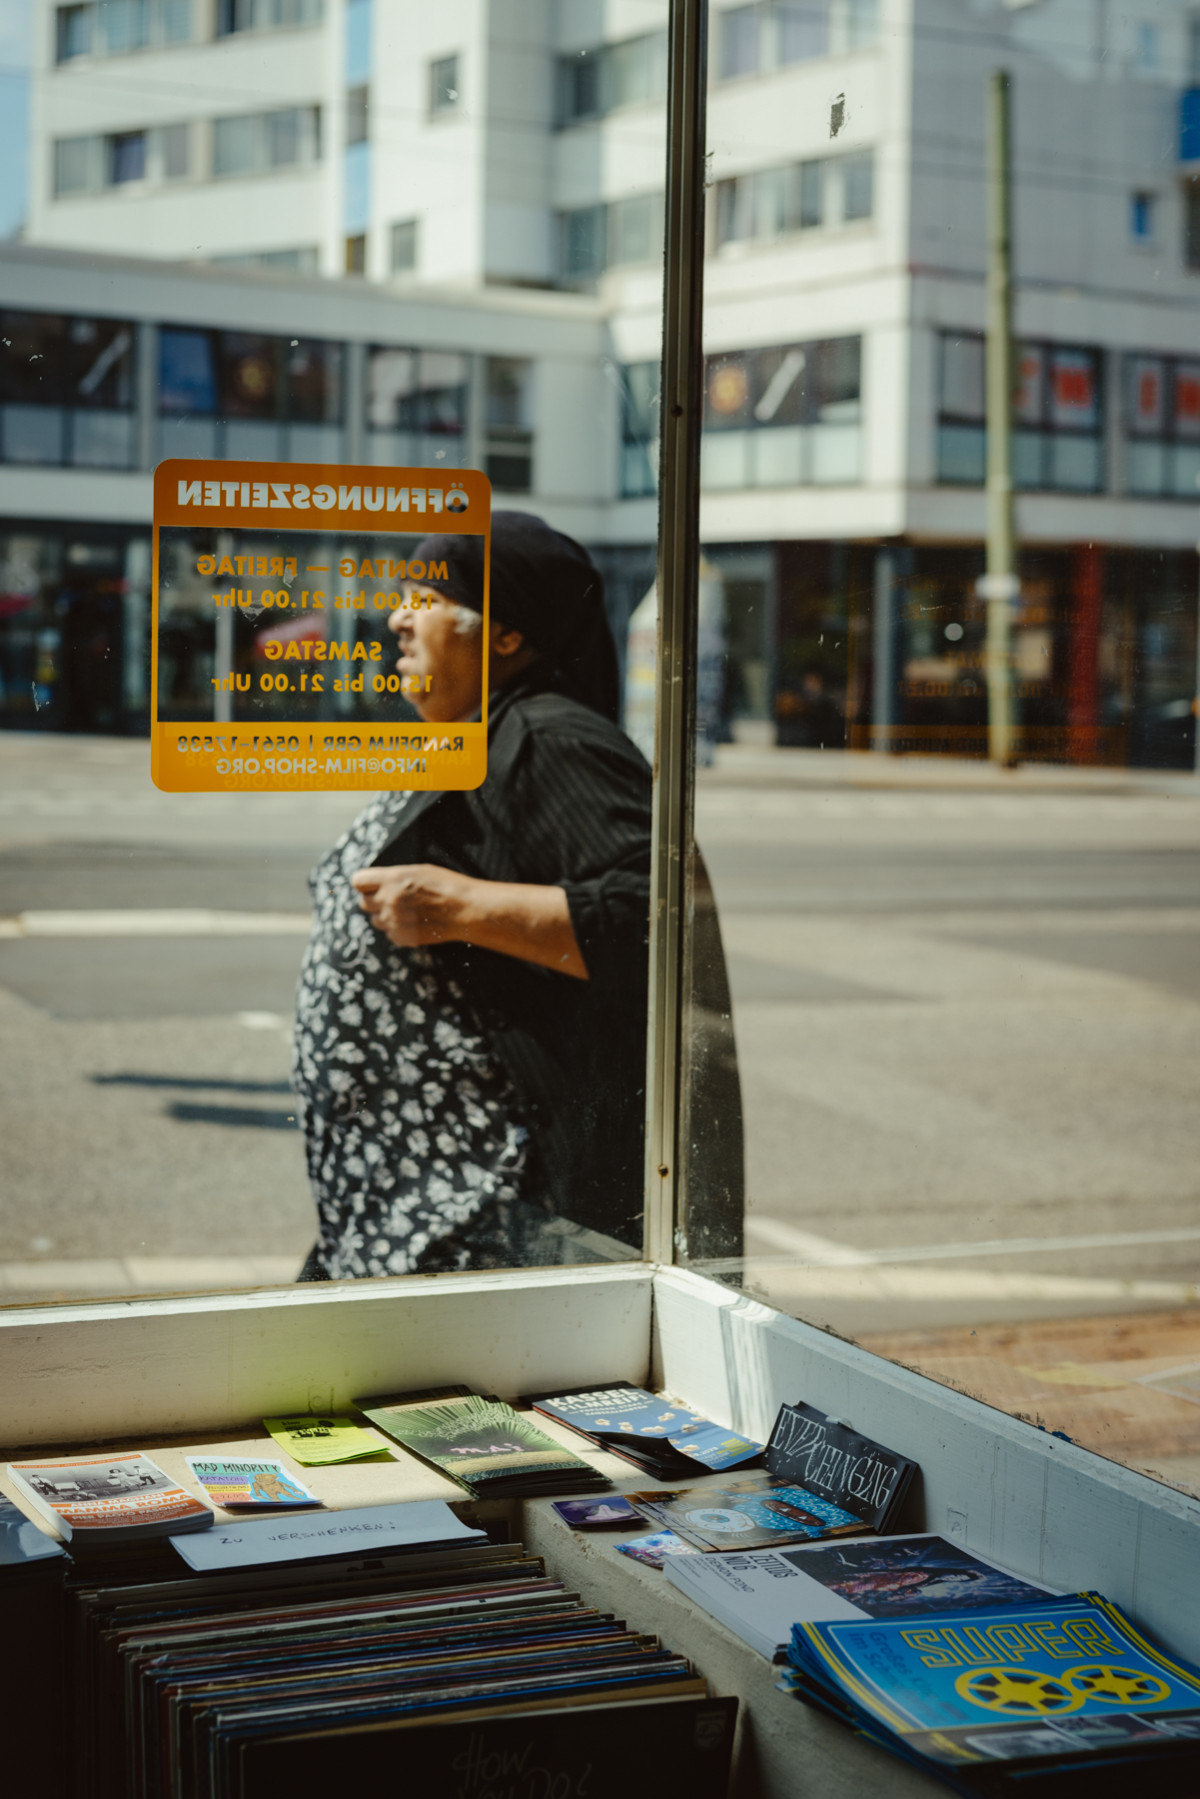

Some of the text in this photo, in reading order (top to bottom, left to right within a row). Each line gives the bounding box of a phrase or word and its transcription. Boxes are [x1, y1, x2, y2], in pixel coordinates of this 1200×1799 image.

[546, 1388, 639, 1408] KASSEL
[192, 1462, 279, 1473] MAD MINORITY
[56, 1494, 193, 1514] MAMMA ROMA
[138, 1502, 189, 1515] PASOLINI
[748, 1554, 798, 1578] ZEITLOS
[899, 1618, 1126, 1668] SUPER
